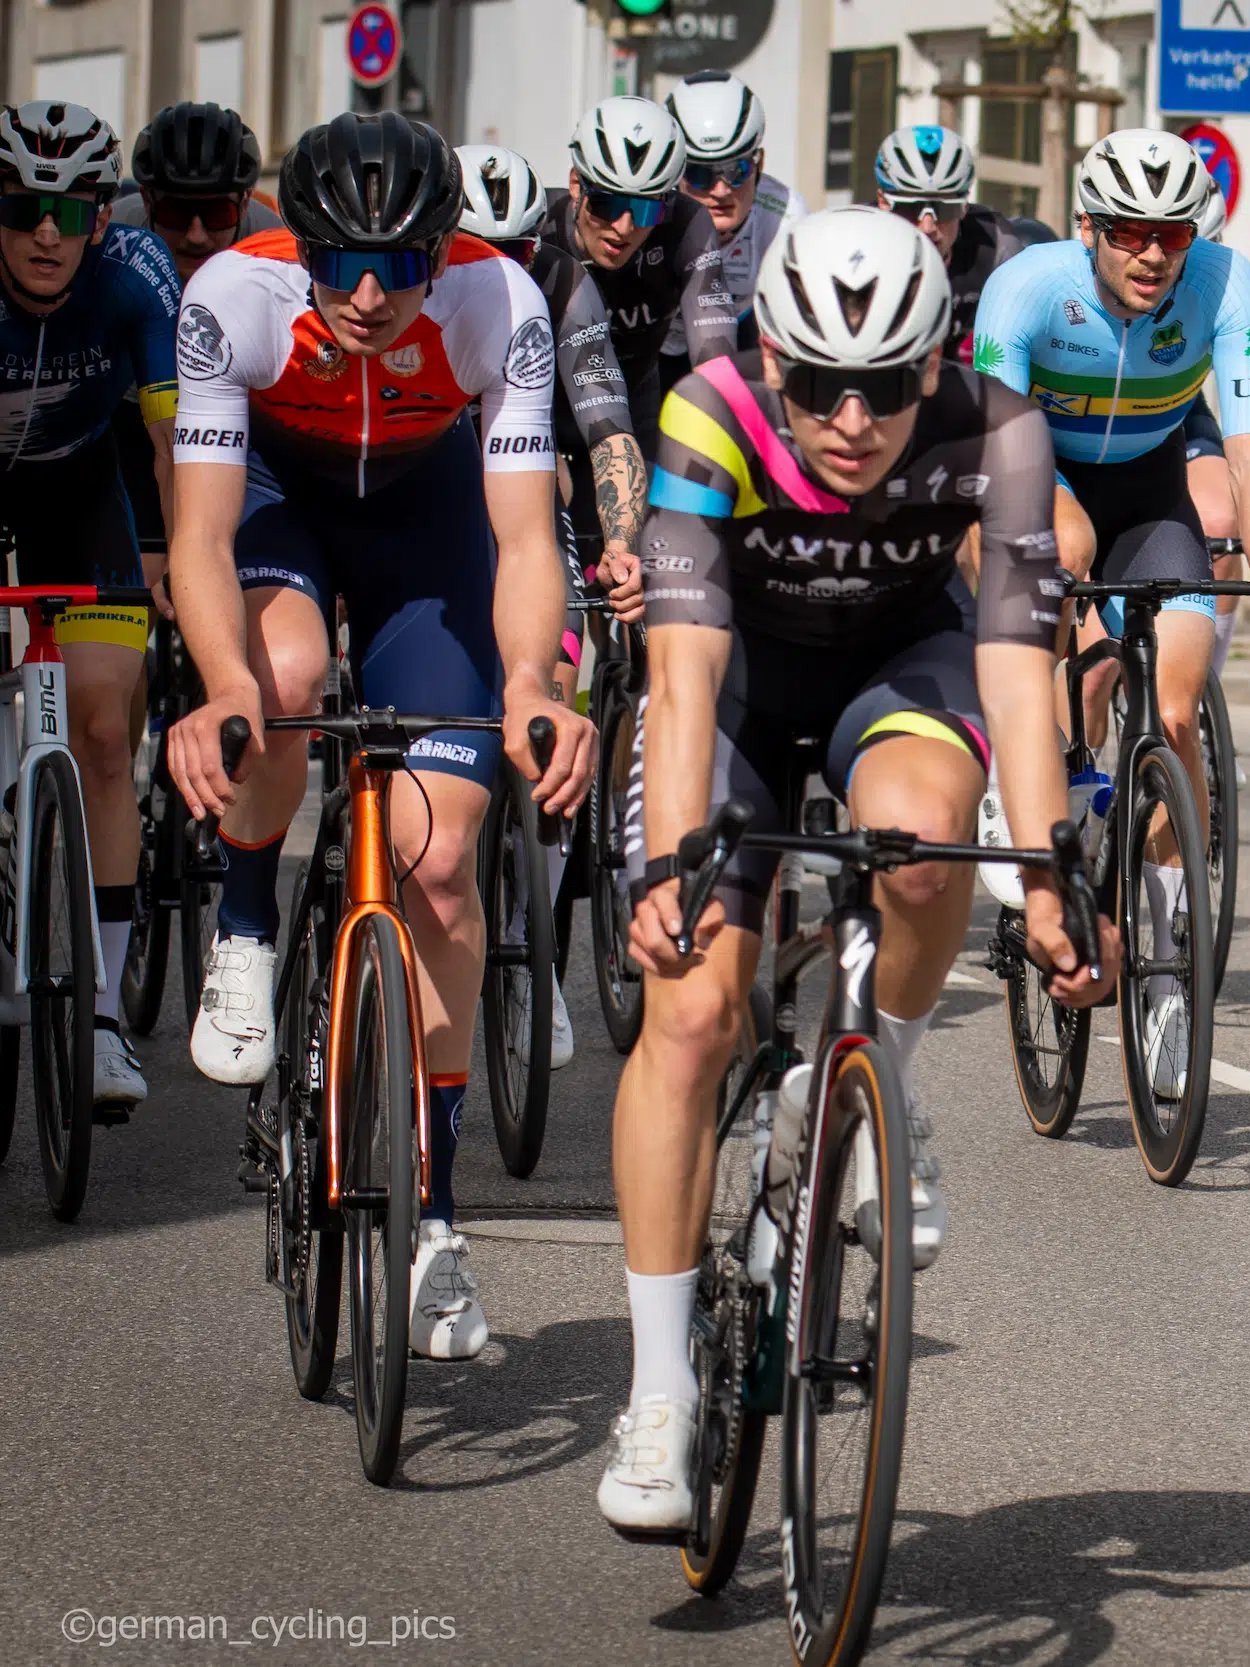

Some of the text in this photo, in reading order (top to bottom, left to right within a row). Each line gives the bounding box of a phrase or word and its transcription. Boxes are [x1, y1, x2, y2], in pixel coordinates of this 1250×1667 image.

[128, 251, 178, 318] Meine Bank
[139, 236, 182, 299] Raiffeisen
[0, 359, 111, 380] ERBIKER
[1067, 341, 1099, 357] BIKES
[489, 437, 554, 454] BIORA
[39, 668, 57, 735] BMC
